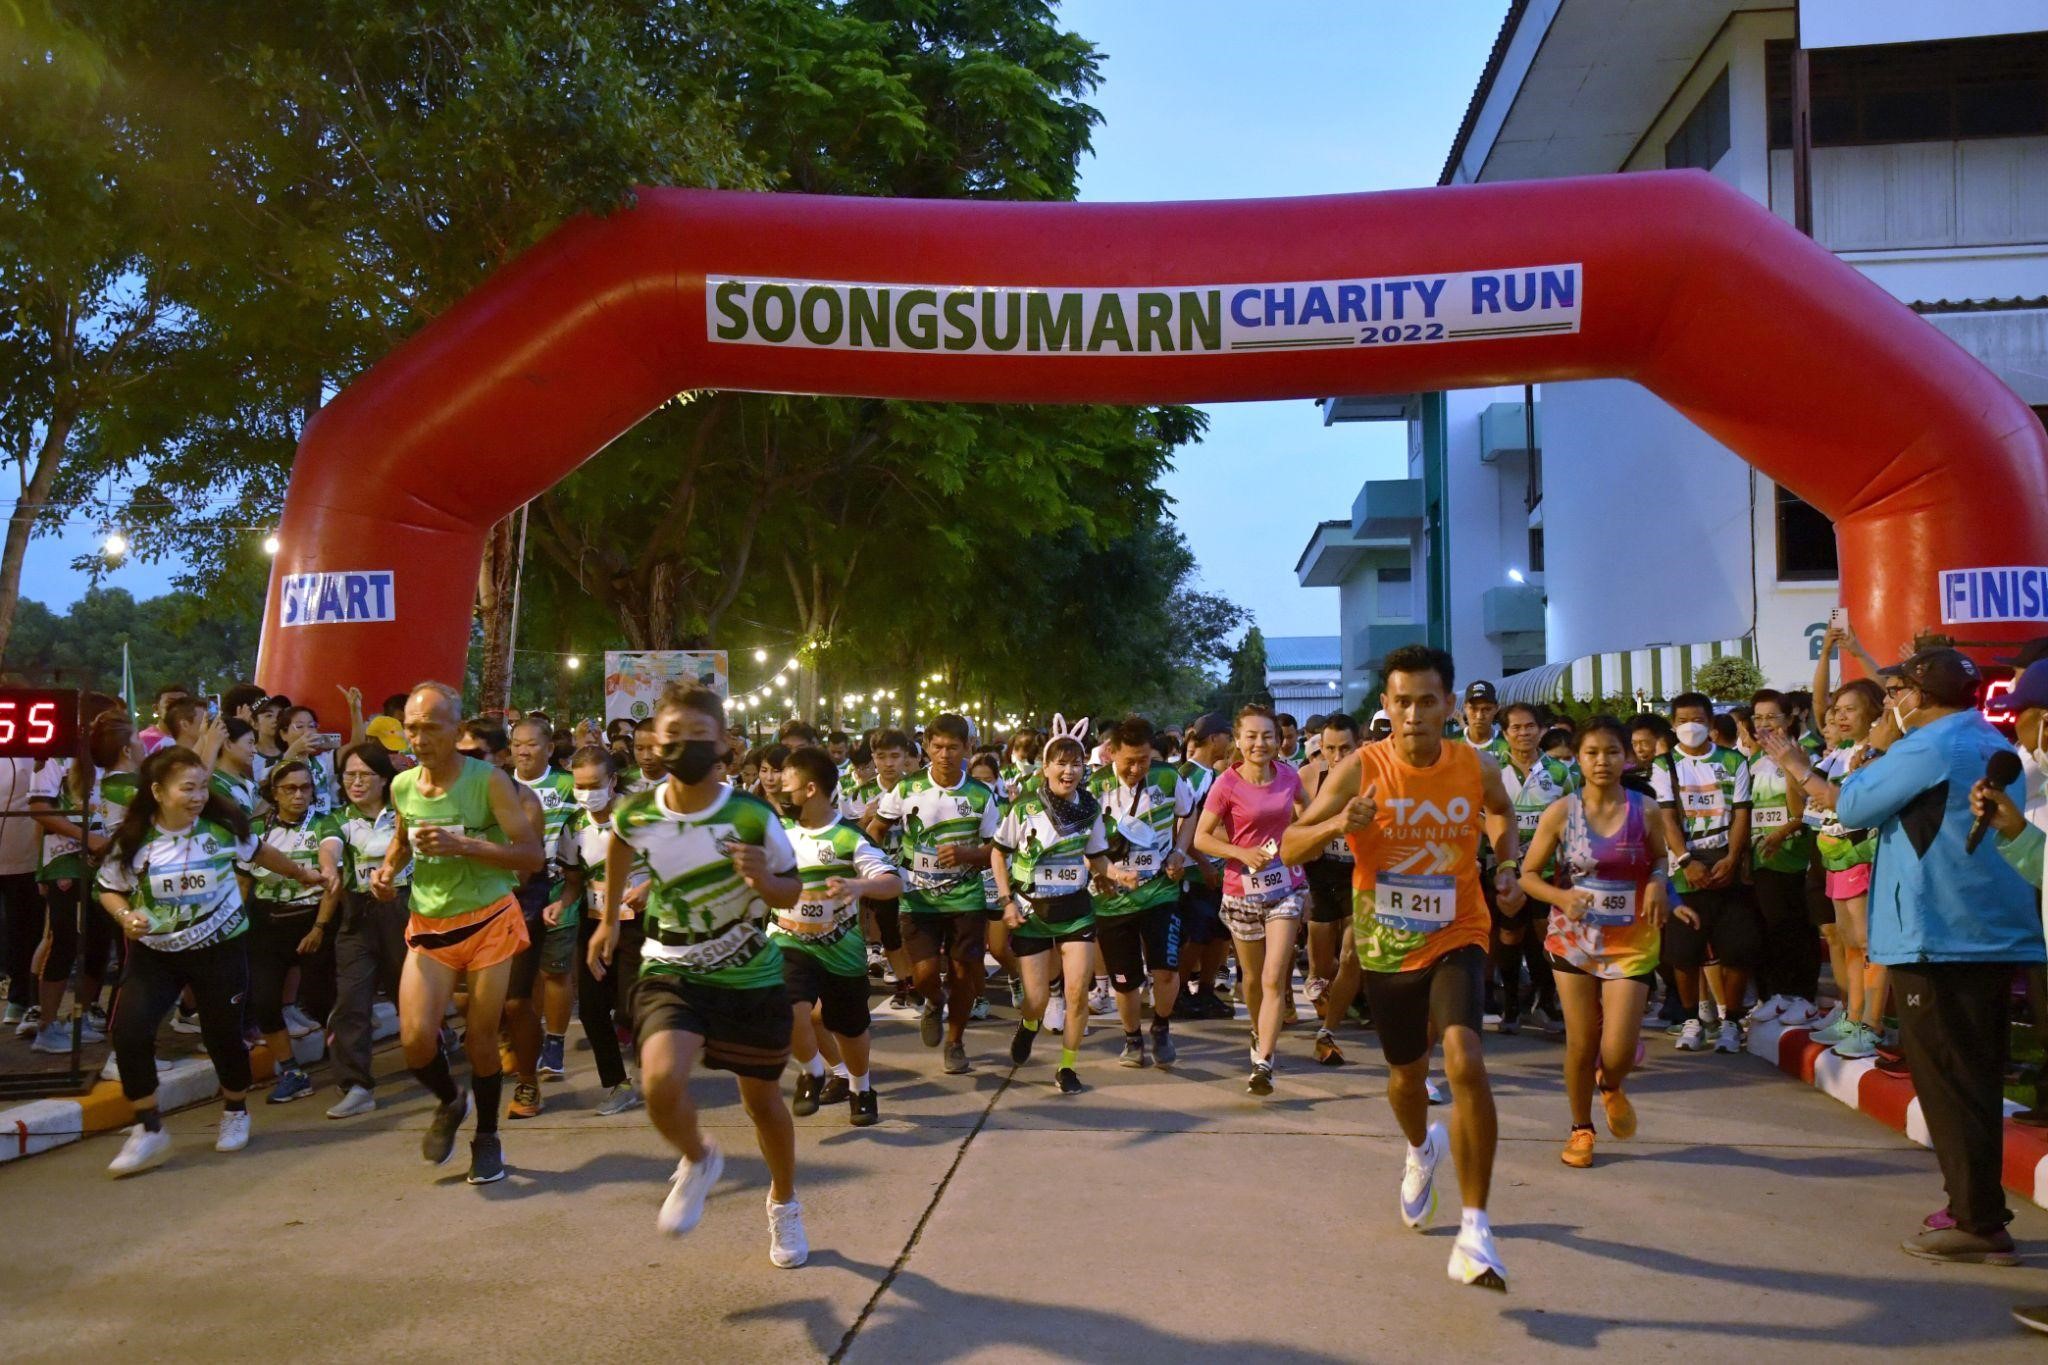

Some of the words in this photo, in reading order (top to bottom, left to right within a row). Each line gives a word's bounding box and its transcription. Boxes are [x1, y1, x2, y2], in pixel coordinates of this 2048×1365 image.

[715, 281, 1222, 352] SOONGSUMARN
[1230, 278, 1447, 328] CHARITY
[1471, 269, 1575, 315] RUN
[1360, 322, 1444, 345] 2022
[284, 574, 390, 623] START
[1697, 794, 1715, 805] 457
[1384, 796, 1471, 826] TAO
[1766, 811, 1782, 822] 372
[1383, 824, 1471, 841] RUNNING
[922, 857, 929, 868] R
[1134, 854, 1153, 866] 496
[1044, 868, 1053, 881] R
[1058, 869, 1078, 881] 495
[1251, 877, 1260, 889] R
[1264, 871, 1283, 887] 592
[163, 879, 174, 893] R
[180, 875, 206, 891] 306
[801, 904, 824, 918] 623
[1391, 891, 1403, 909] R
[1412, 894, 1441, 915] 211
[1602, 895, 1626, 910] 459
